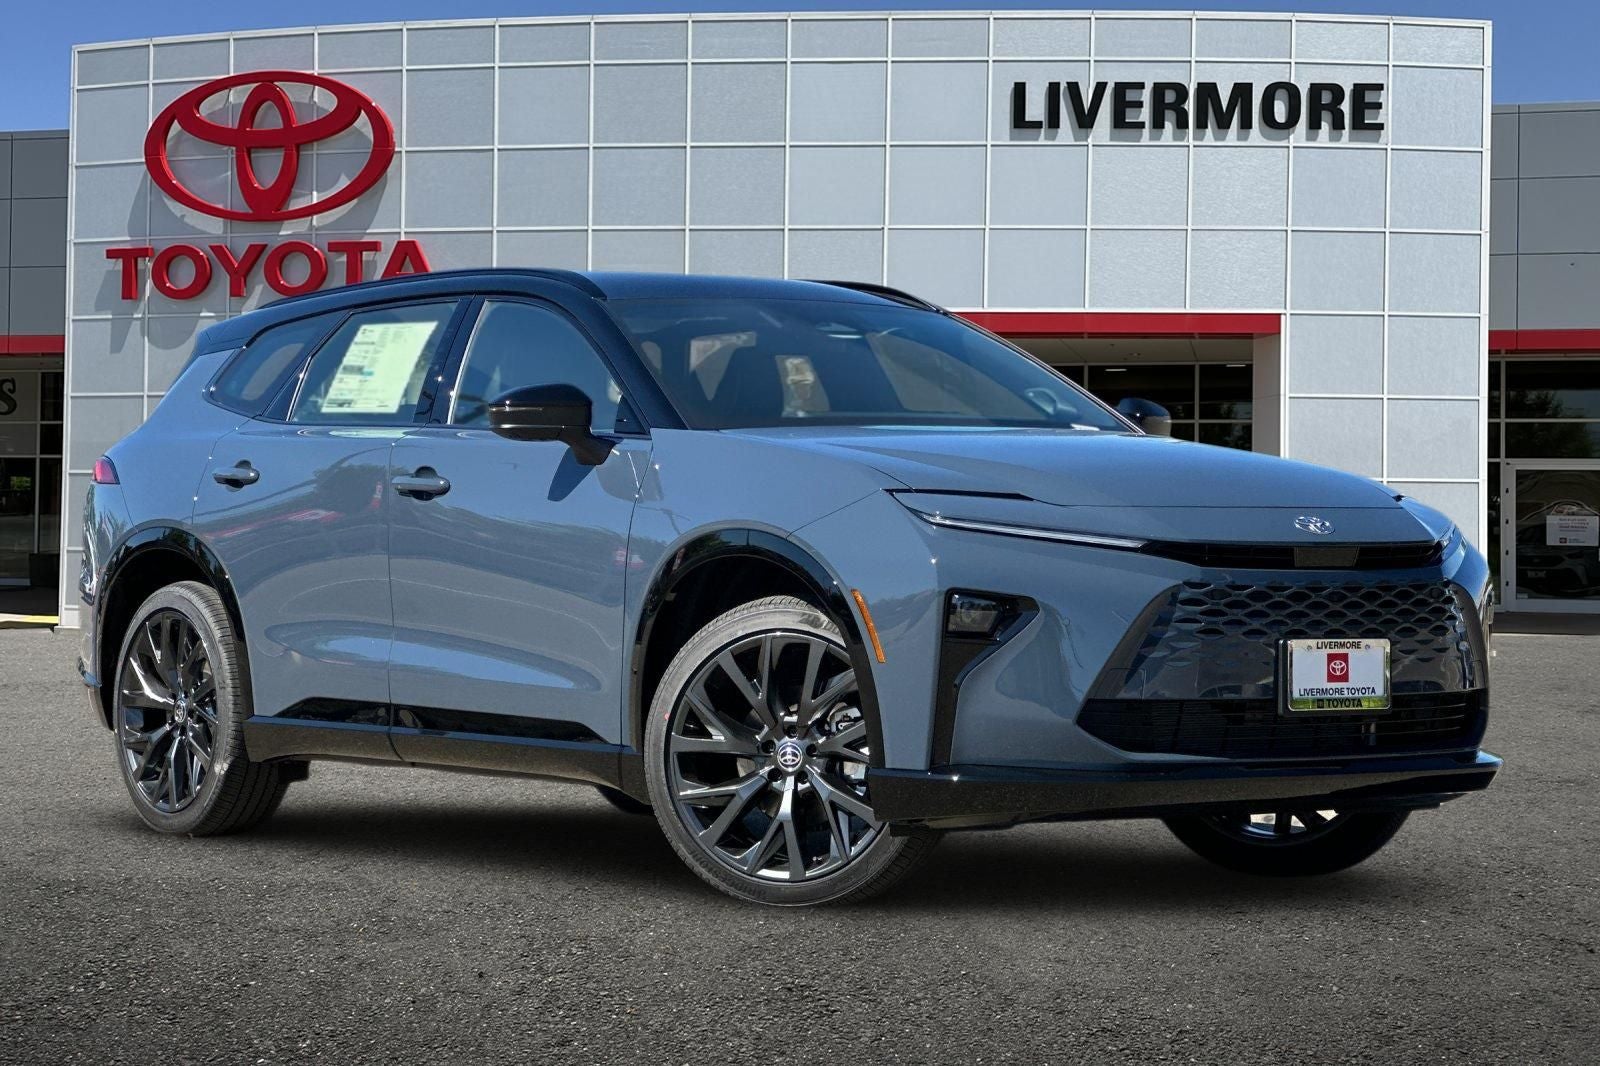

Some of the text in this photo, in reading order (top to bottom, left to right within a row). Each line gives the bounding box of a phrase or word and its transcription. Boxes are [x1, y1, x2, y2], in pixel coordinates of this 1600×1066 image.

[1013, 81, 1385, 131] LIVERMORE
[106, 240, 431, 300] TOYOTA
[1316, 641, 1362, 650] LIVERMORE
[1299, 686, 1376, 697] LIVERMORE TOYOTA
[1327, 698, 1363, 708] TOYOTA
